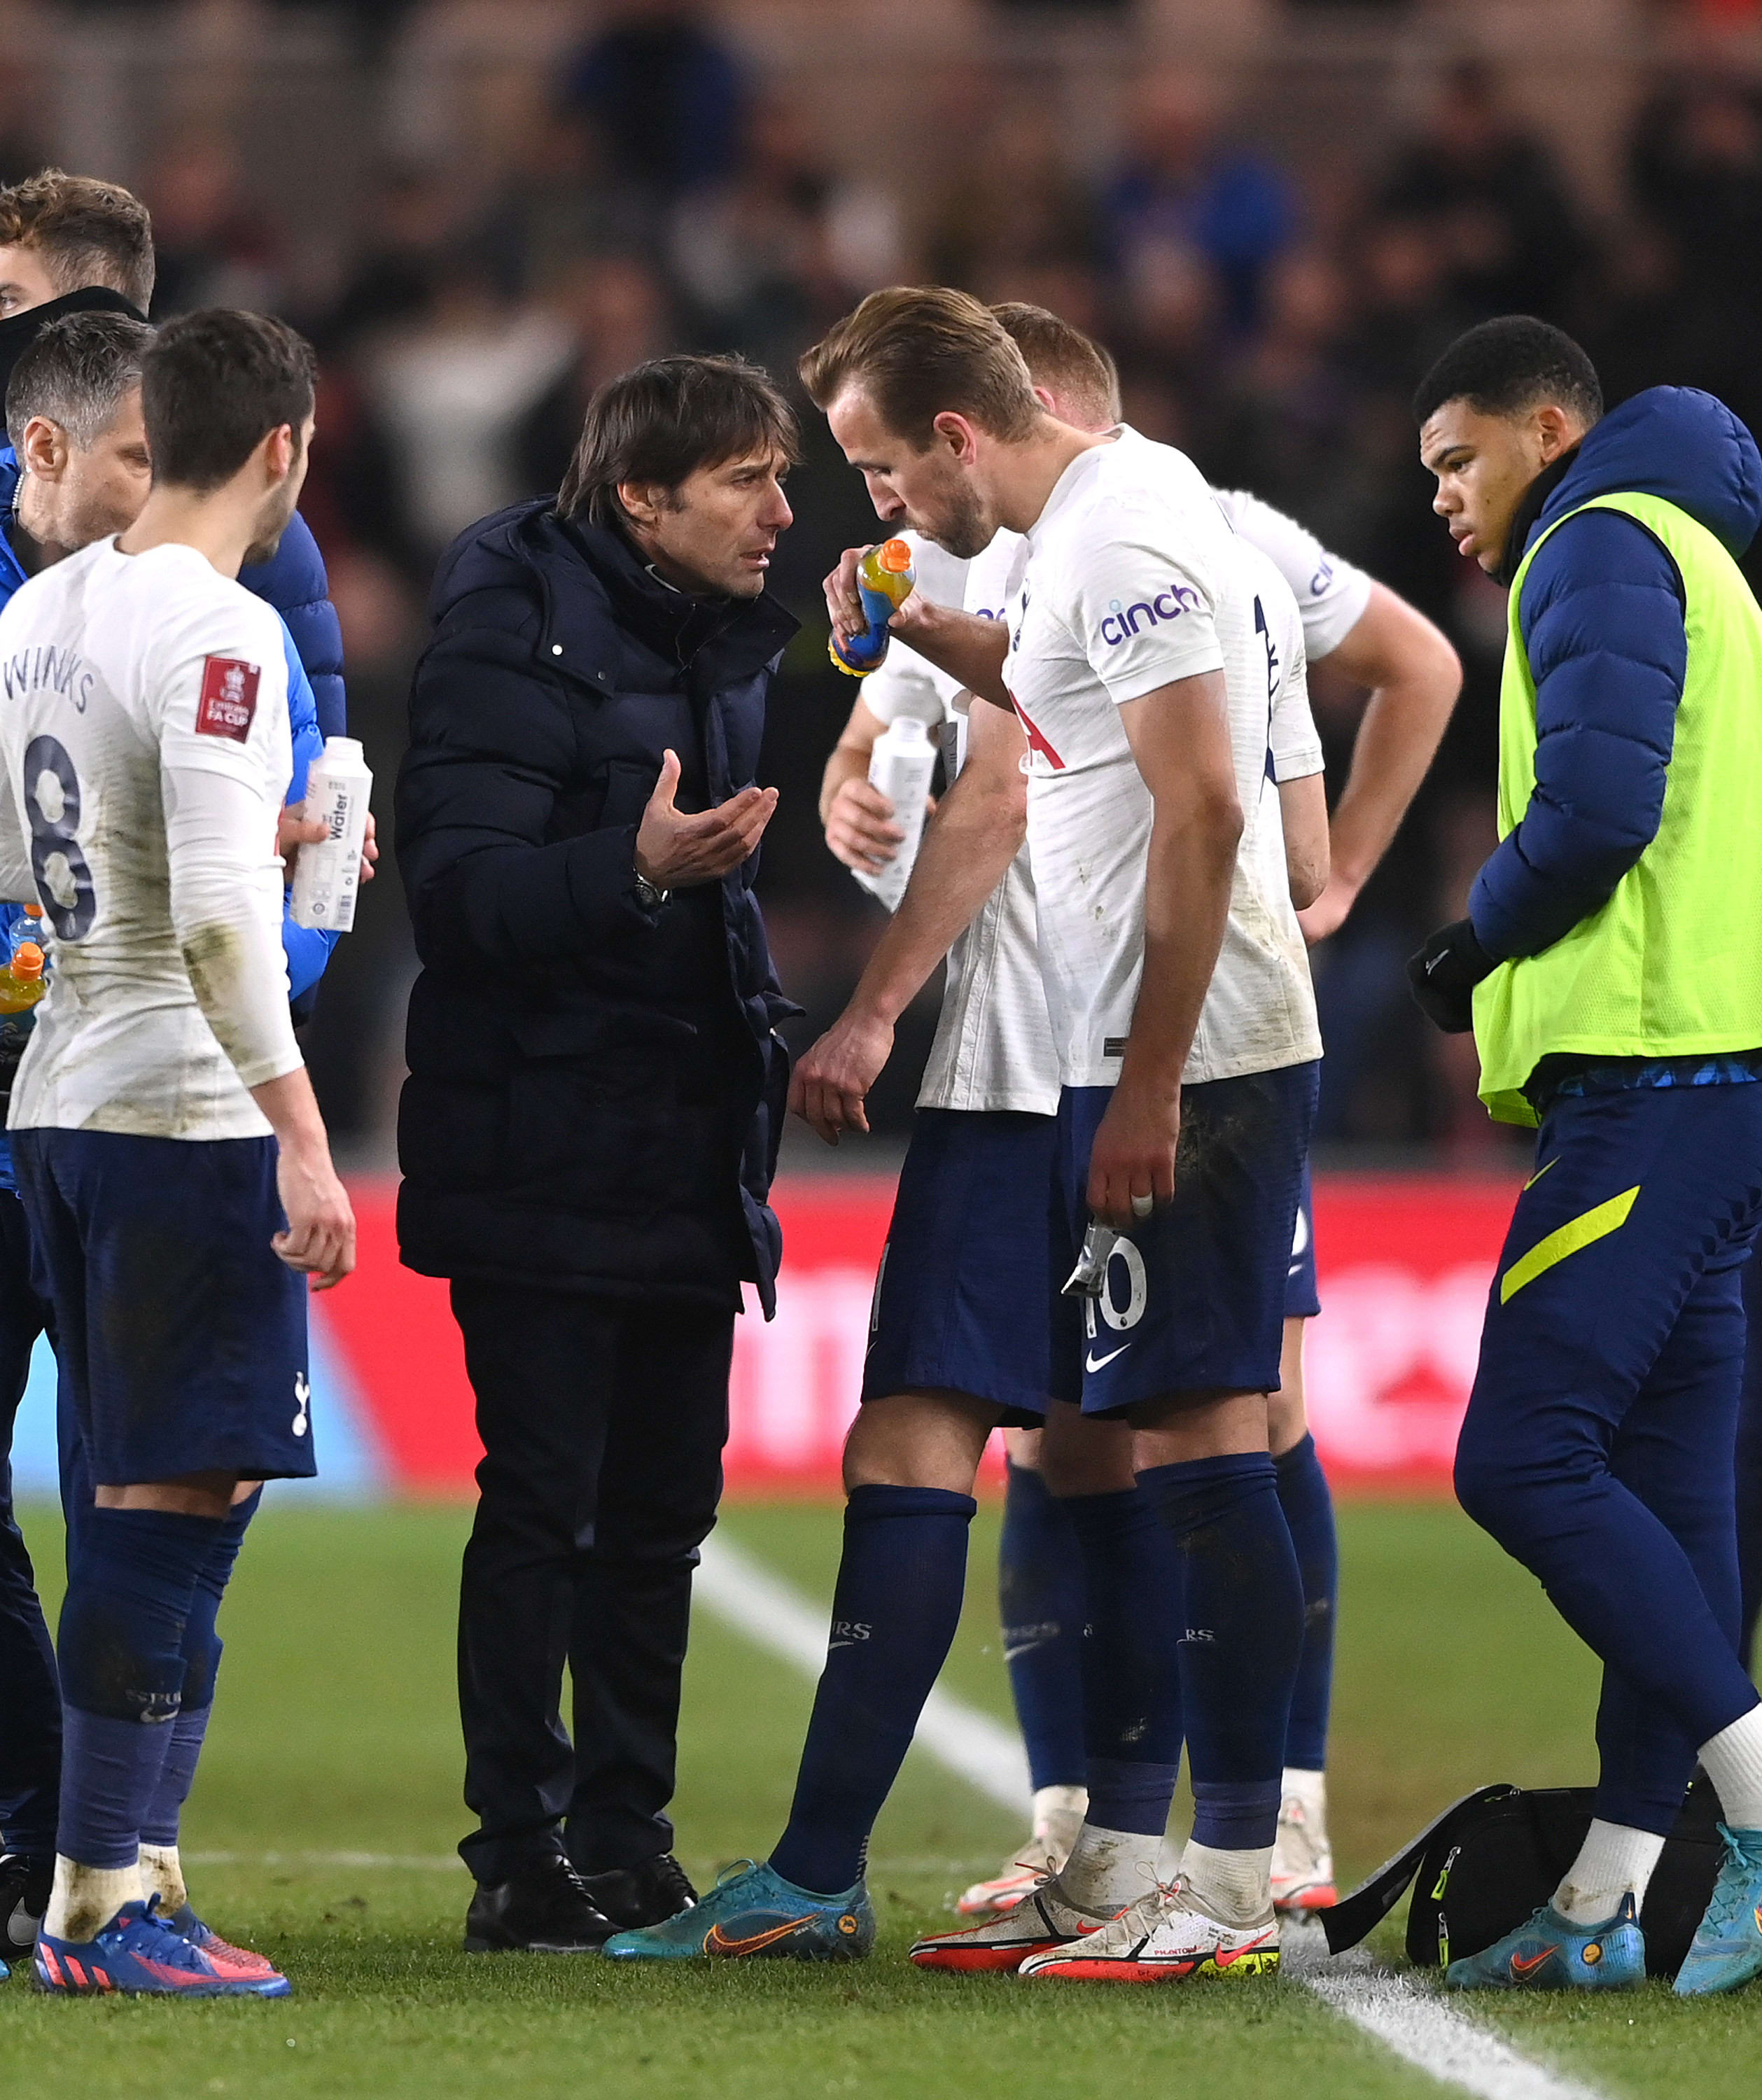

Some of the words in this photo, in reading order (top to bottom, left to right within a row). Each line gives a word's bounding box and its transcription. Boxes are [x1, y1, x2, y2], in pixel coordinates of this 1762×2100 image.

[1101, 584, 1201, 645] cinch
[4, 645, 94, 714] WINKS
[24, 734, 97, 941] 8
[329, 794, 348, 841] Water
